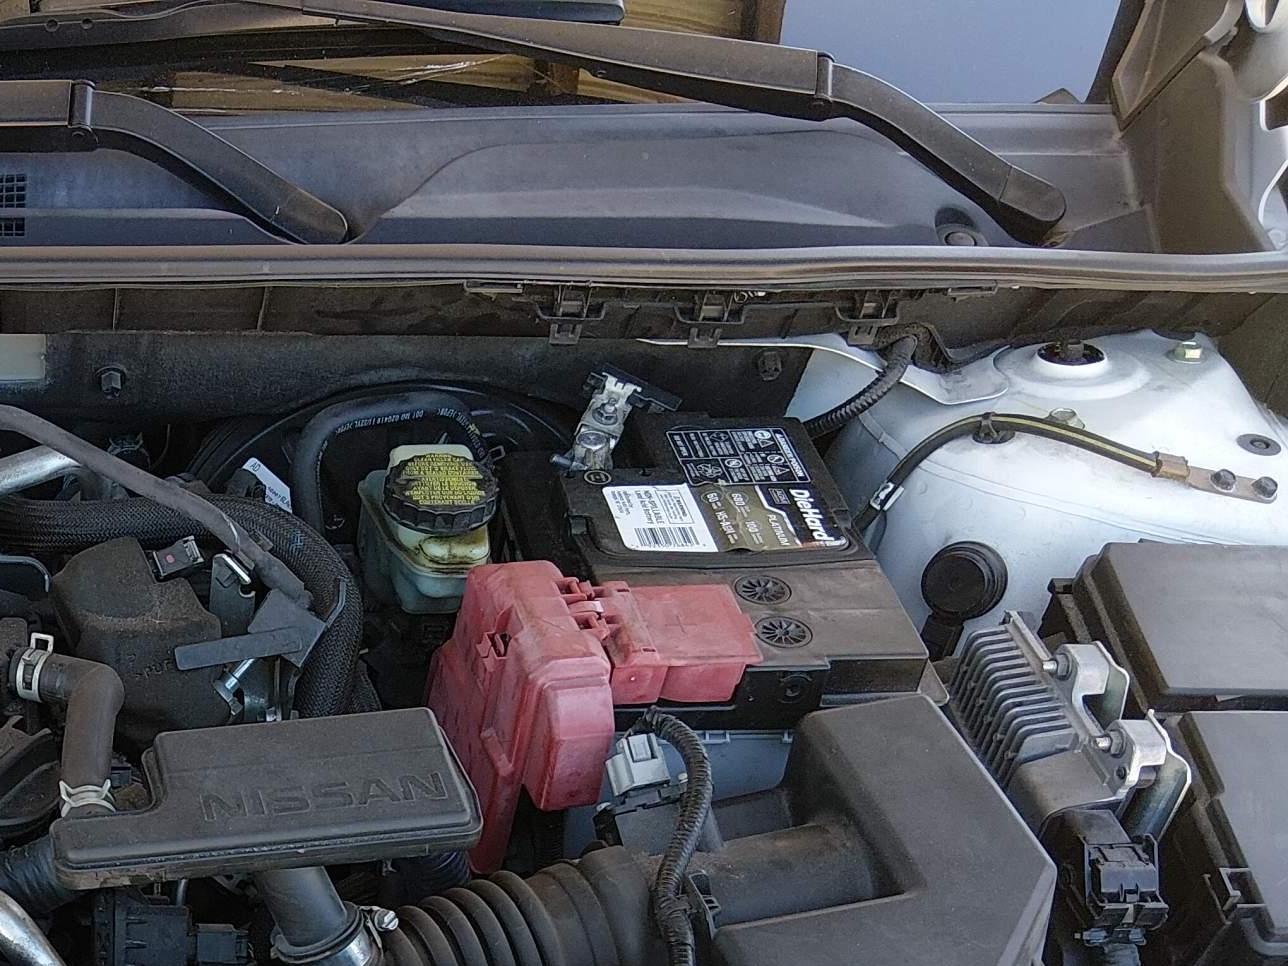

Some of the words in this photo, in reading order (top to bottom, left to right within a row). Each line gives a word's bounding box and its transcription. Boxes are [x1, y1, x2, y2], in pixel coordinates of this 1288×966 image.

[767, 514, 791, 546] PLATINUM
[789, 488, 835, 542] DieHard
[199, 771, 450, 823] NISSAN
